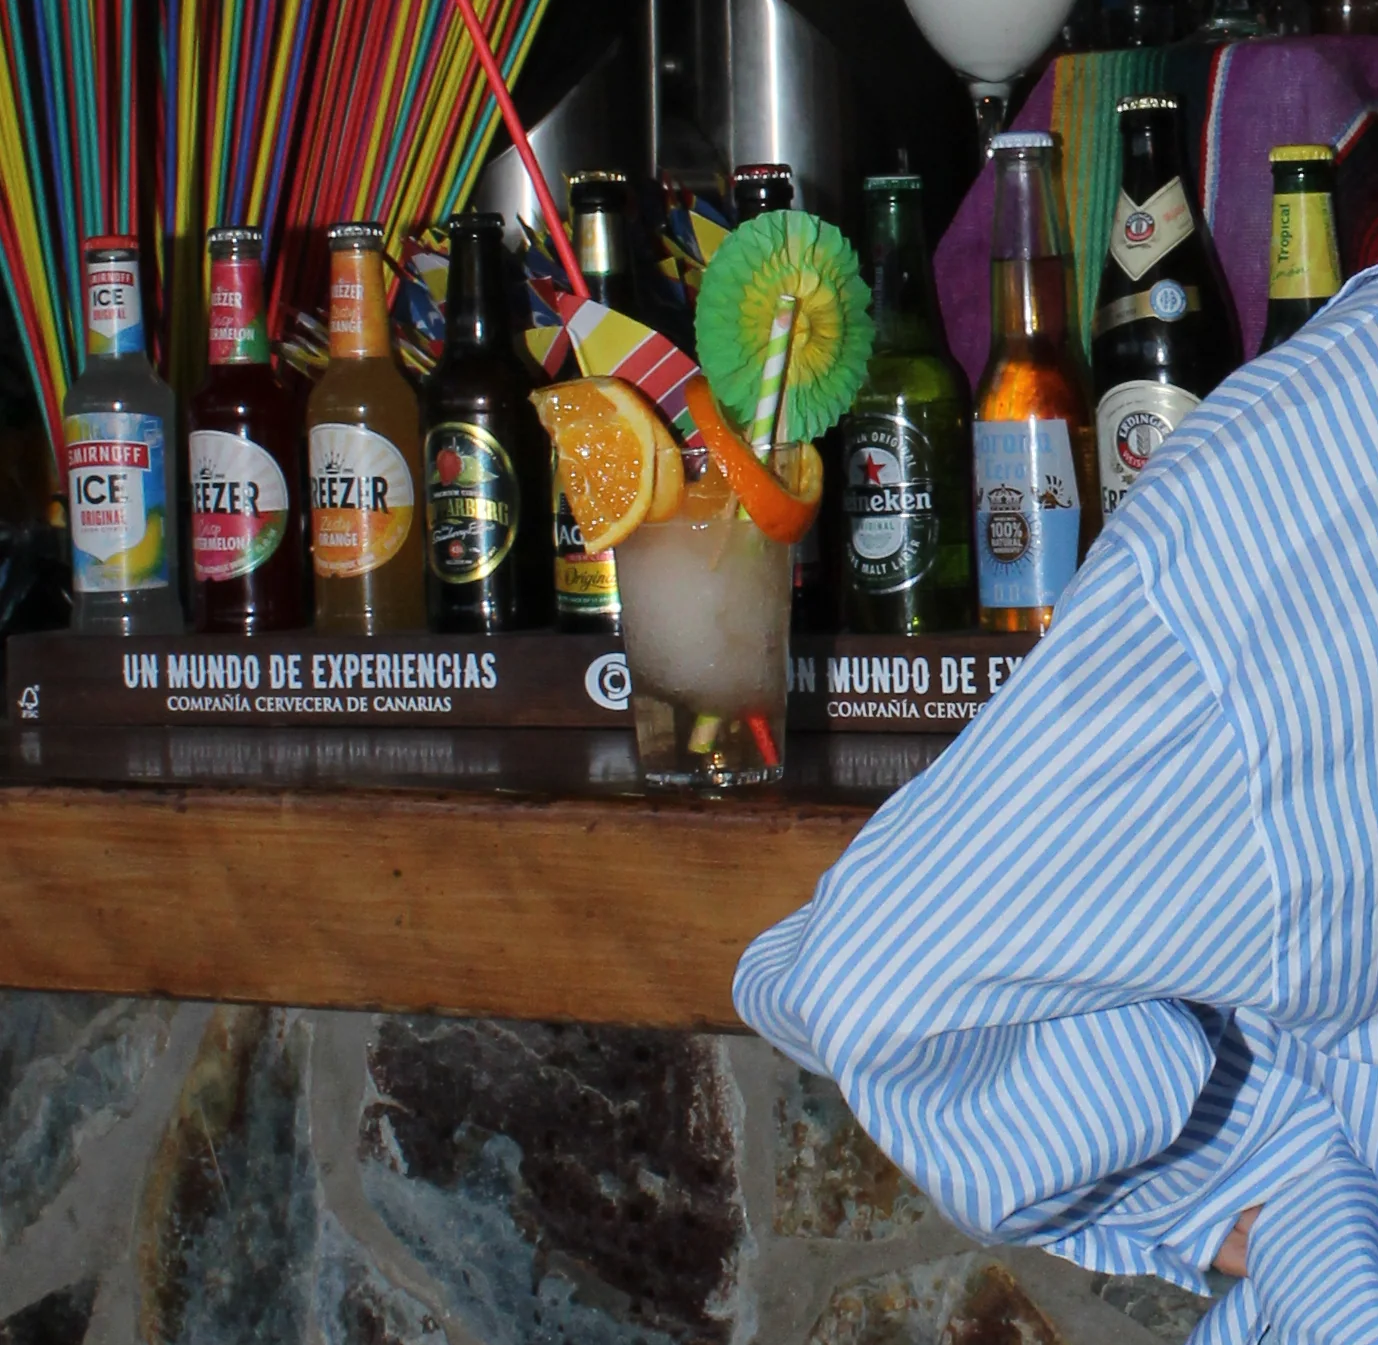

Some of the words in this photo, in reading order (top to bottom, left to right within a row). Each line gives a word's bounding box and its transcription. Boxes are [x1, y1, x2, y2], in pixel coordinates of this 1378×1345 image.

[1278, 203, 1293, 263] Tropical
[92, 289, 124, 306] ICE
[67, 446, 142, 465] SMIRNOFF
[76, 474, 128, 505] ICE
[319, 533, 359, 546] ORANGE
[990, 522, 1023, 538] 100%
[861, 562, 888, 575] MALT
[122, 653, 158, 689] UN
[166, 653, 260, 690] MUNDO
[269, 653, 302, 689] DE
[311, 652, 498, 690] EXPERIENCIAS
[827, 656, 930, 695] MUNDO
[940, 656, 976, 694] DE
[166, 692, 252, 713] COMPAÑÍA
[255, 695, 345, 713] CERVECERA
[347, 696, 368, 712] DE
[372, 695, 453, 713] CANARIAS
[826, 697, 919, 719] COMPAÑÍA
